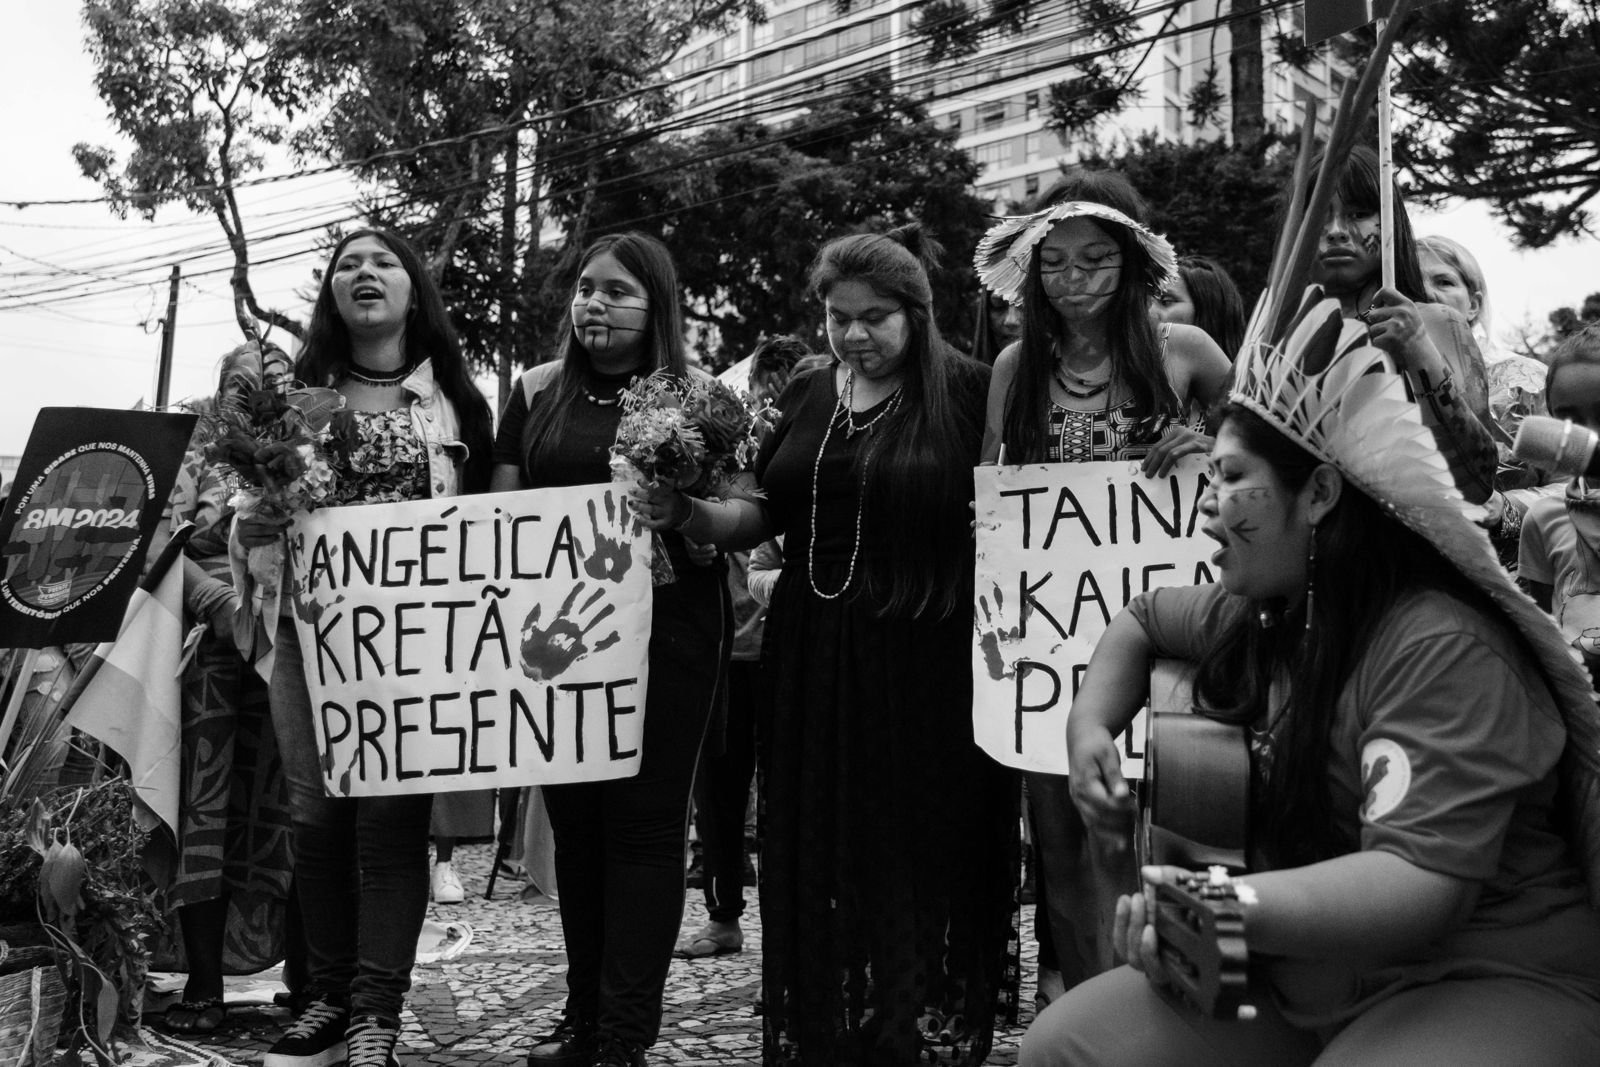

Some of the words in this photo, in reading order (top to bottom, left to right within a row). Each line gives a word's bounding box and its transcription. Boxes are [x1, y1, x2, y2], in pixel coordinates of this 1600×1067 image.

[14, 496, 30, 515] POR
[26, 475, 45, 495] UMA
[43, 448, 77, 475] CIDADE
[77, 442, 97, 453] QUE
[97, 441, 118, 450] NOS
[117, 444, 151, 476] MANTENHA
[146, 473, 156, 500] VIVAS
[1, 584, 12, 600] UM
[62, 599, 82, 613] QUE
[82, 584, 104, 602] NOS
[313, 584, 513, 686] KRETÃ
[321, 677, 638, 782] PRESENTE
